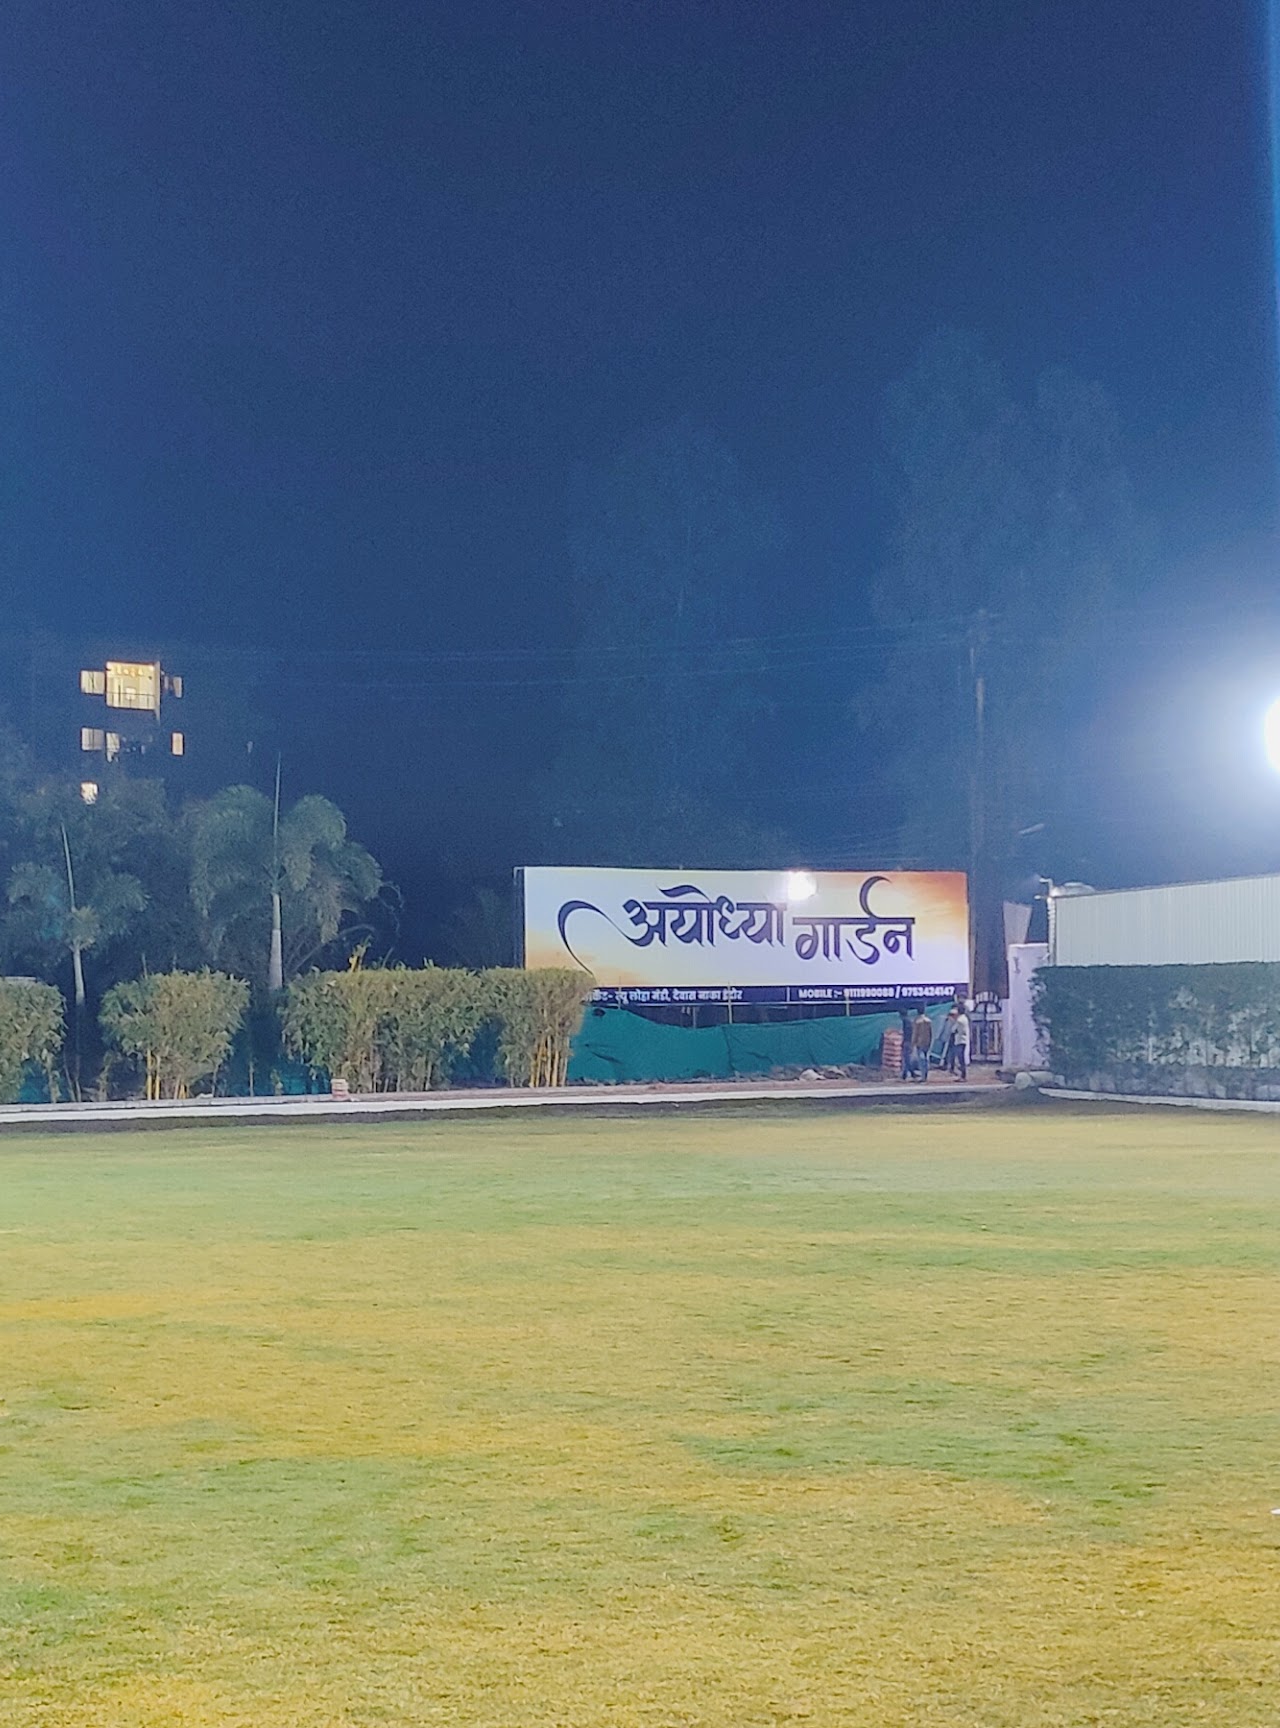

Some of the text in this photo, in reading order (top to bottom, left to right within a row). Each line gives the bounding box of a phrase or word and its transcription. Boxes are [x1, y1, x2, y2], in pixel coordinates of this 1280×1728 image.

[558, 876, 916, 976] अयोध्या गार्डन
[798, 988, 833, 999] MOBILE
